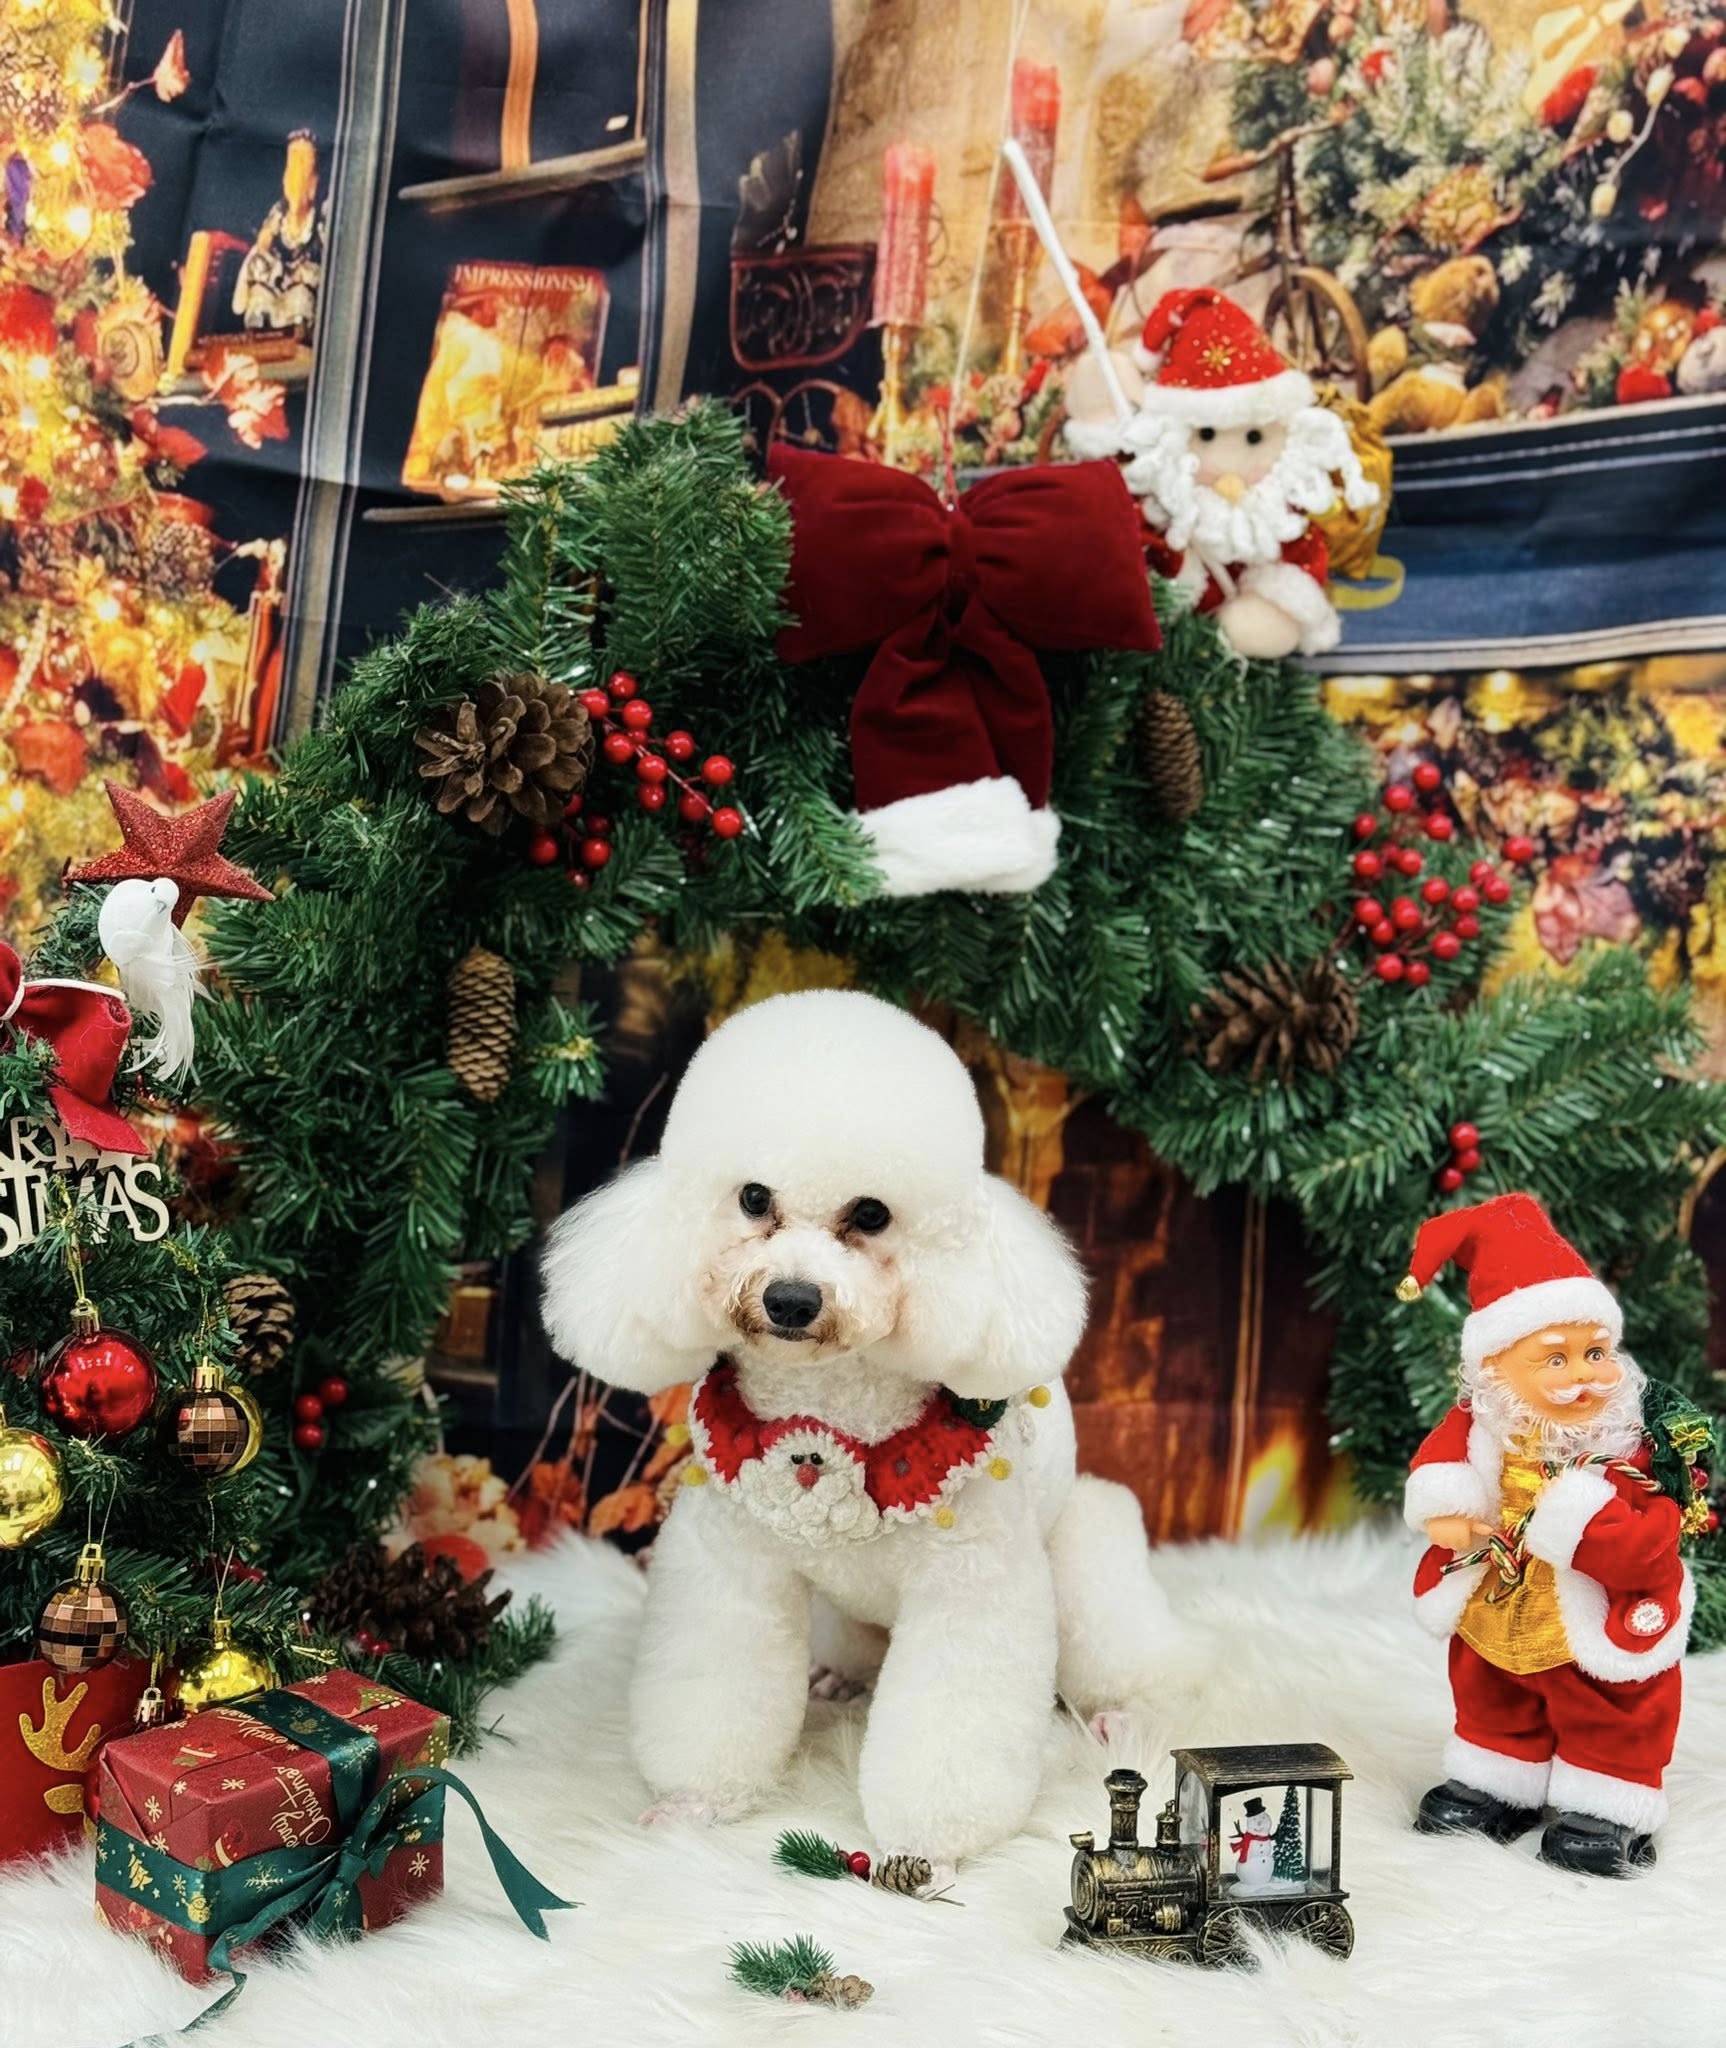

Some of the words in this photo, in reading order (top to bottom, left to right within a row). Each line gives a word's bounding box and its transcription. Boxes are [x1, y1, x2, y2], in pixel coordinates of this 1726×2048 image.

[454, 264, 594, 292] IMPRESSIONISM
[271, 1766, 332, 1846] Christmas
[269, 1810, 305, 1848] erry
